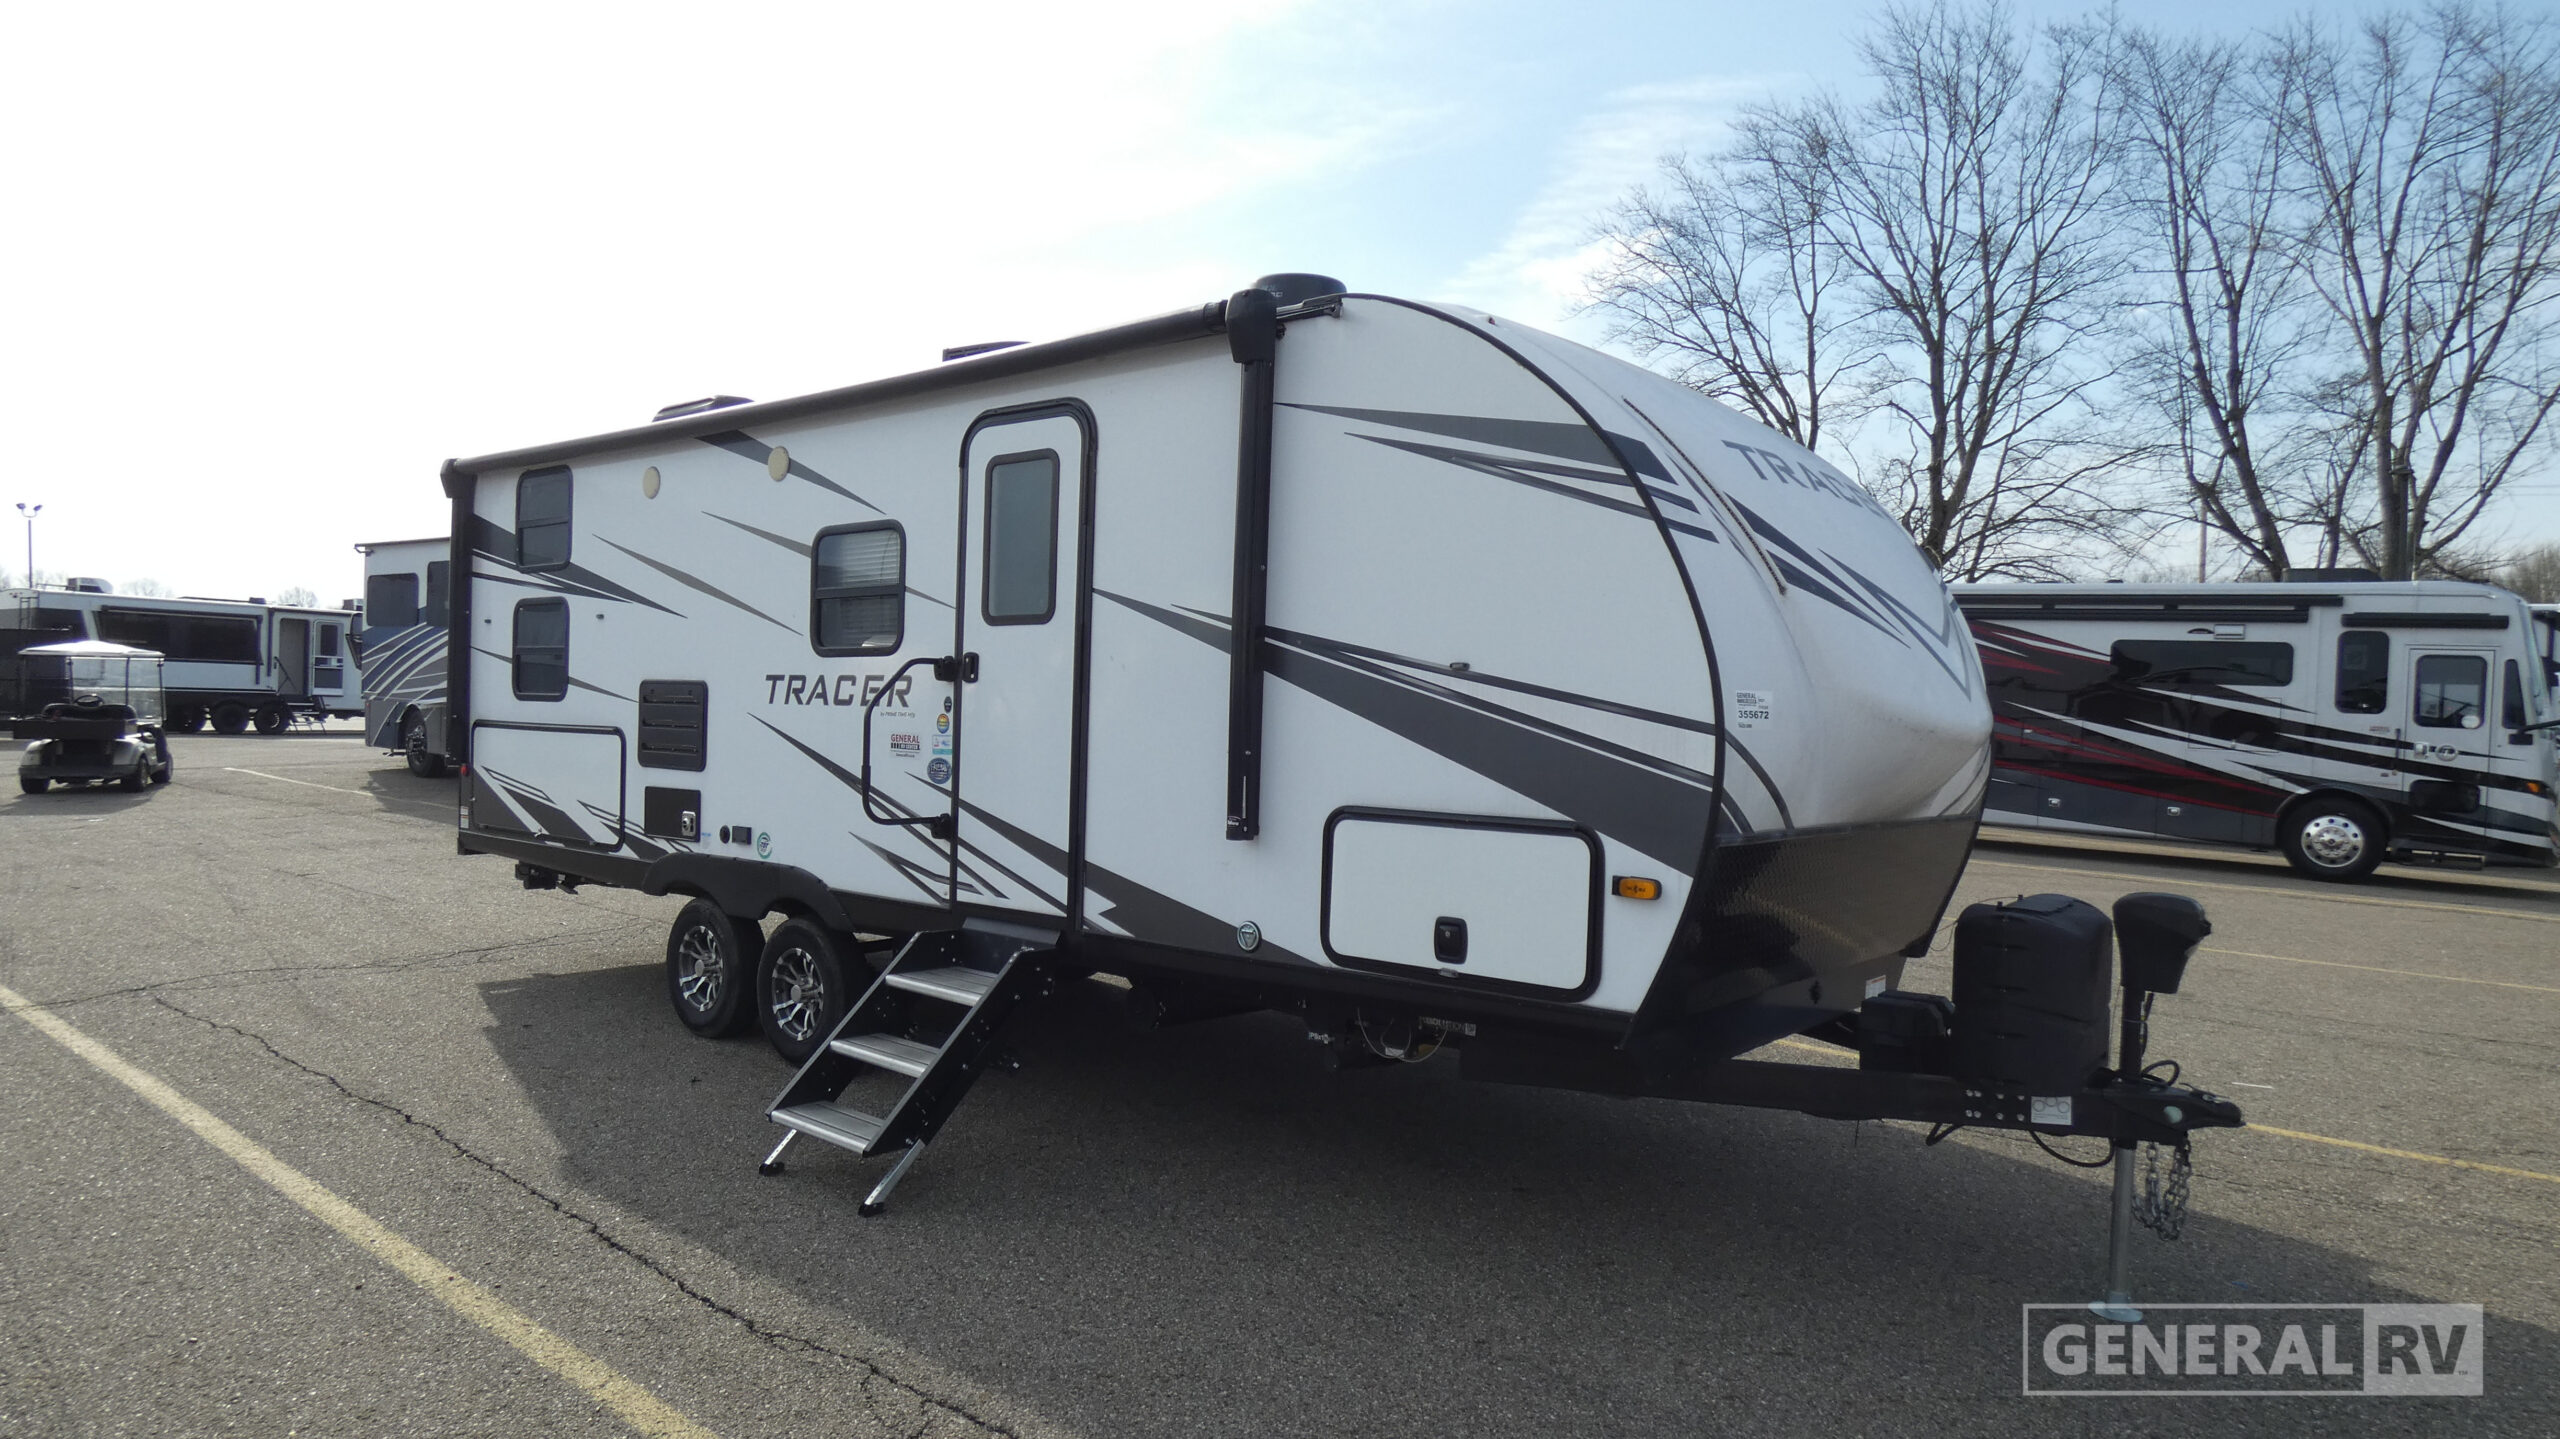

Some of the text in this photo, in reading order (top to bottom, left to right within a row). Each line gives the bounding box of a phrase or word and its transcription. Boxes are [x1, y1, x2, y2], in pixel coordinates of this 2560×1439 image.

[765, 674, 913, 708] TRACER
[1738, 710, 1769, 720] 355672
[890, 733, 920, 744] GENERAL
